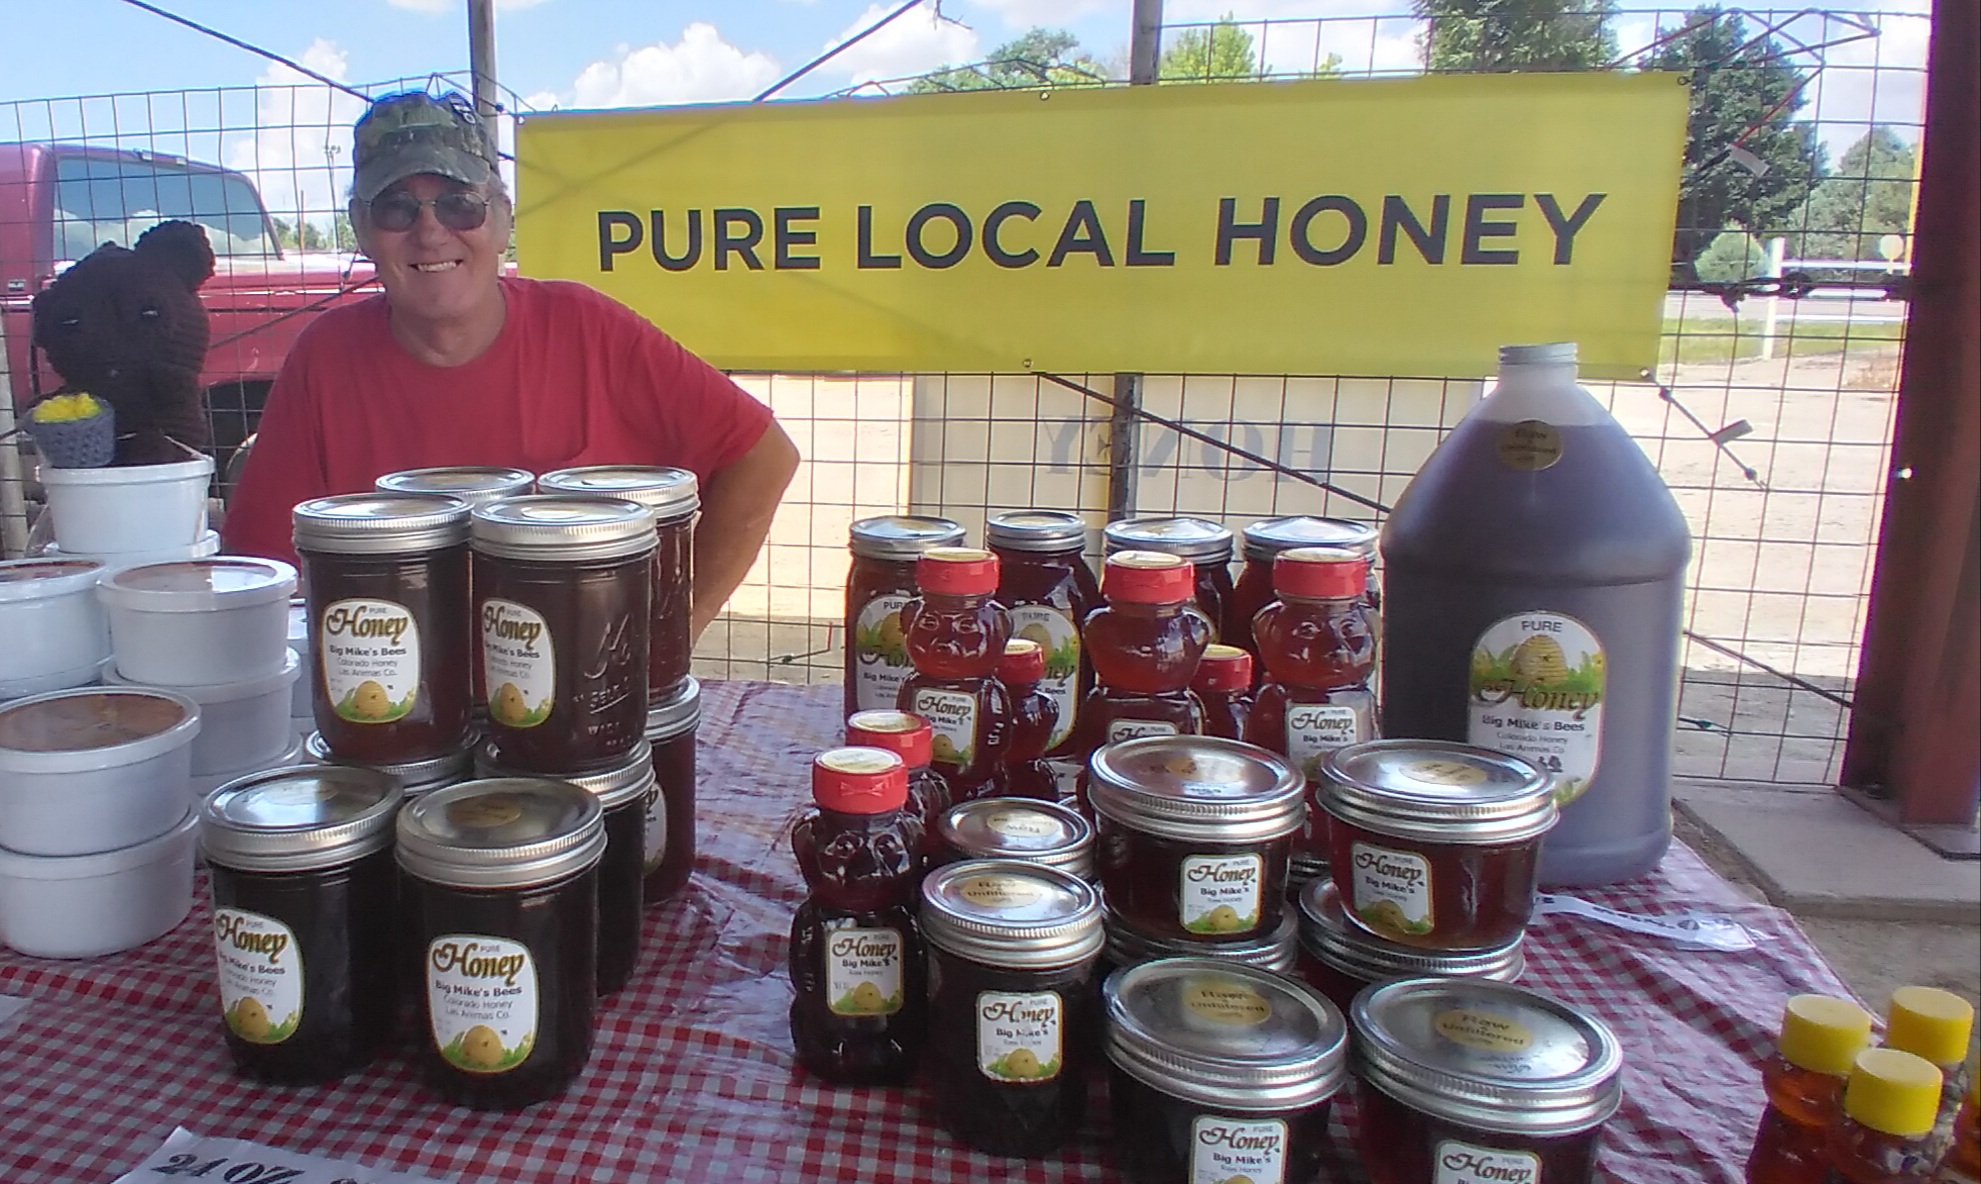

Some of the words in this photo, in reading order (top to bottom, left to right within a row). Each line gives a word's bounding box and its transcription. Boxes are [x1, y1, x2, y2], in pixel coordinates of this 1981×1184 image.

[598, 206, 820, 272] PURE
[857, 199, 1175, 269] LOCAL
[1214, 192, 1608, 267] HONEY
[884, 601, 904, 611] PUR
[325, 605, 408, 646] Honey
[484, 606, 541, 650] Honey
[1521, 620, 1563, 633] PURE
[329, 645, 343, 657] Big
[345, 647, 379, 657] Mike's
[381, 647, 407, 657] Bees
[517, 648, 541, 659] Bees
[860, 644, 915, 668] Hon
[372, 660, 399, 669] Honey
[863, 672, 877, 682] Big
[1473, 677, 1599, 721] Honey
[918, 695, 972, 726] Honey
[1291, 711, 1352, 735] Honey
[1482, 714, 1503, 728] Big
[1507, 717, 1550, 731] Mike's
[1554, 721, 1585, 732] Bees
[1303, 735, 1318, 743] Big
[1497, 731, 1538, 743] Colorado
[1540, 735, 1569, 745] Honey
[1517, 744, 1550, 753] Animas
[1188, 863, 1257, 886] Honey
[1355, 852, 1422, 887] Honey
[1200, 887, 1218, 897] Big
[1219, 887, 1249, 896] Mike's
[1365, 876, 1380, 888] Big
[1381, 881, 1416, 895] Mike's
[216, 913, 288, 965] Honey
[480, 944, 500, 953] PURE
[832, 935, 897, 961] Honey
[258, 964, 286, 976] Bees
[432, 942, 525, 987] Honey
[841, 959, 858, 968] Big
[435, 980, 452, 994] Big
[453, 984, 490, 998] Mike's
[493, 986, 523, 998] Bees
[483, 1000, 514, 1010] Honey
[461, 1010, 494, 1020] Animas
[996, 1028, 1013, 1039] Big
[1253, 1125, 1274, 1133] PURE
[1199, 1126, 1280, 1156] Honey
[1213, 1152, 1232, 1165] Big
[1236, 1155, 1272, 1166] Mike's
[1442, 1152, 1532, 1184] Honey
